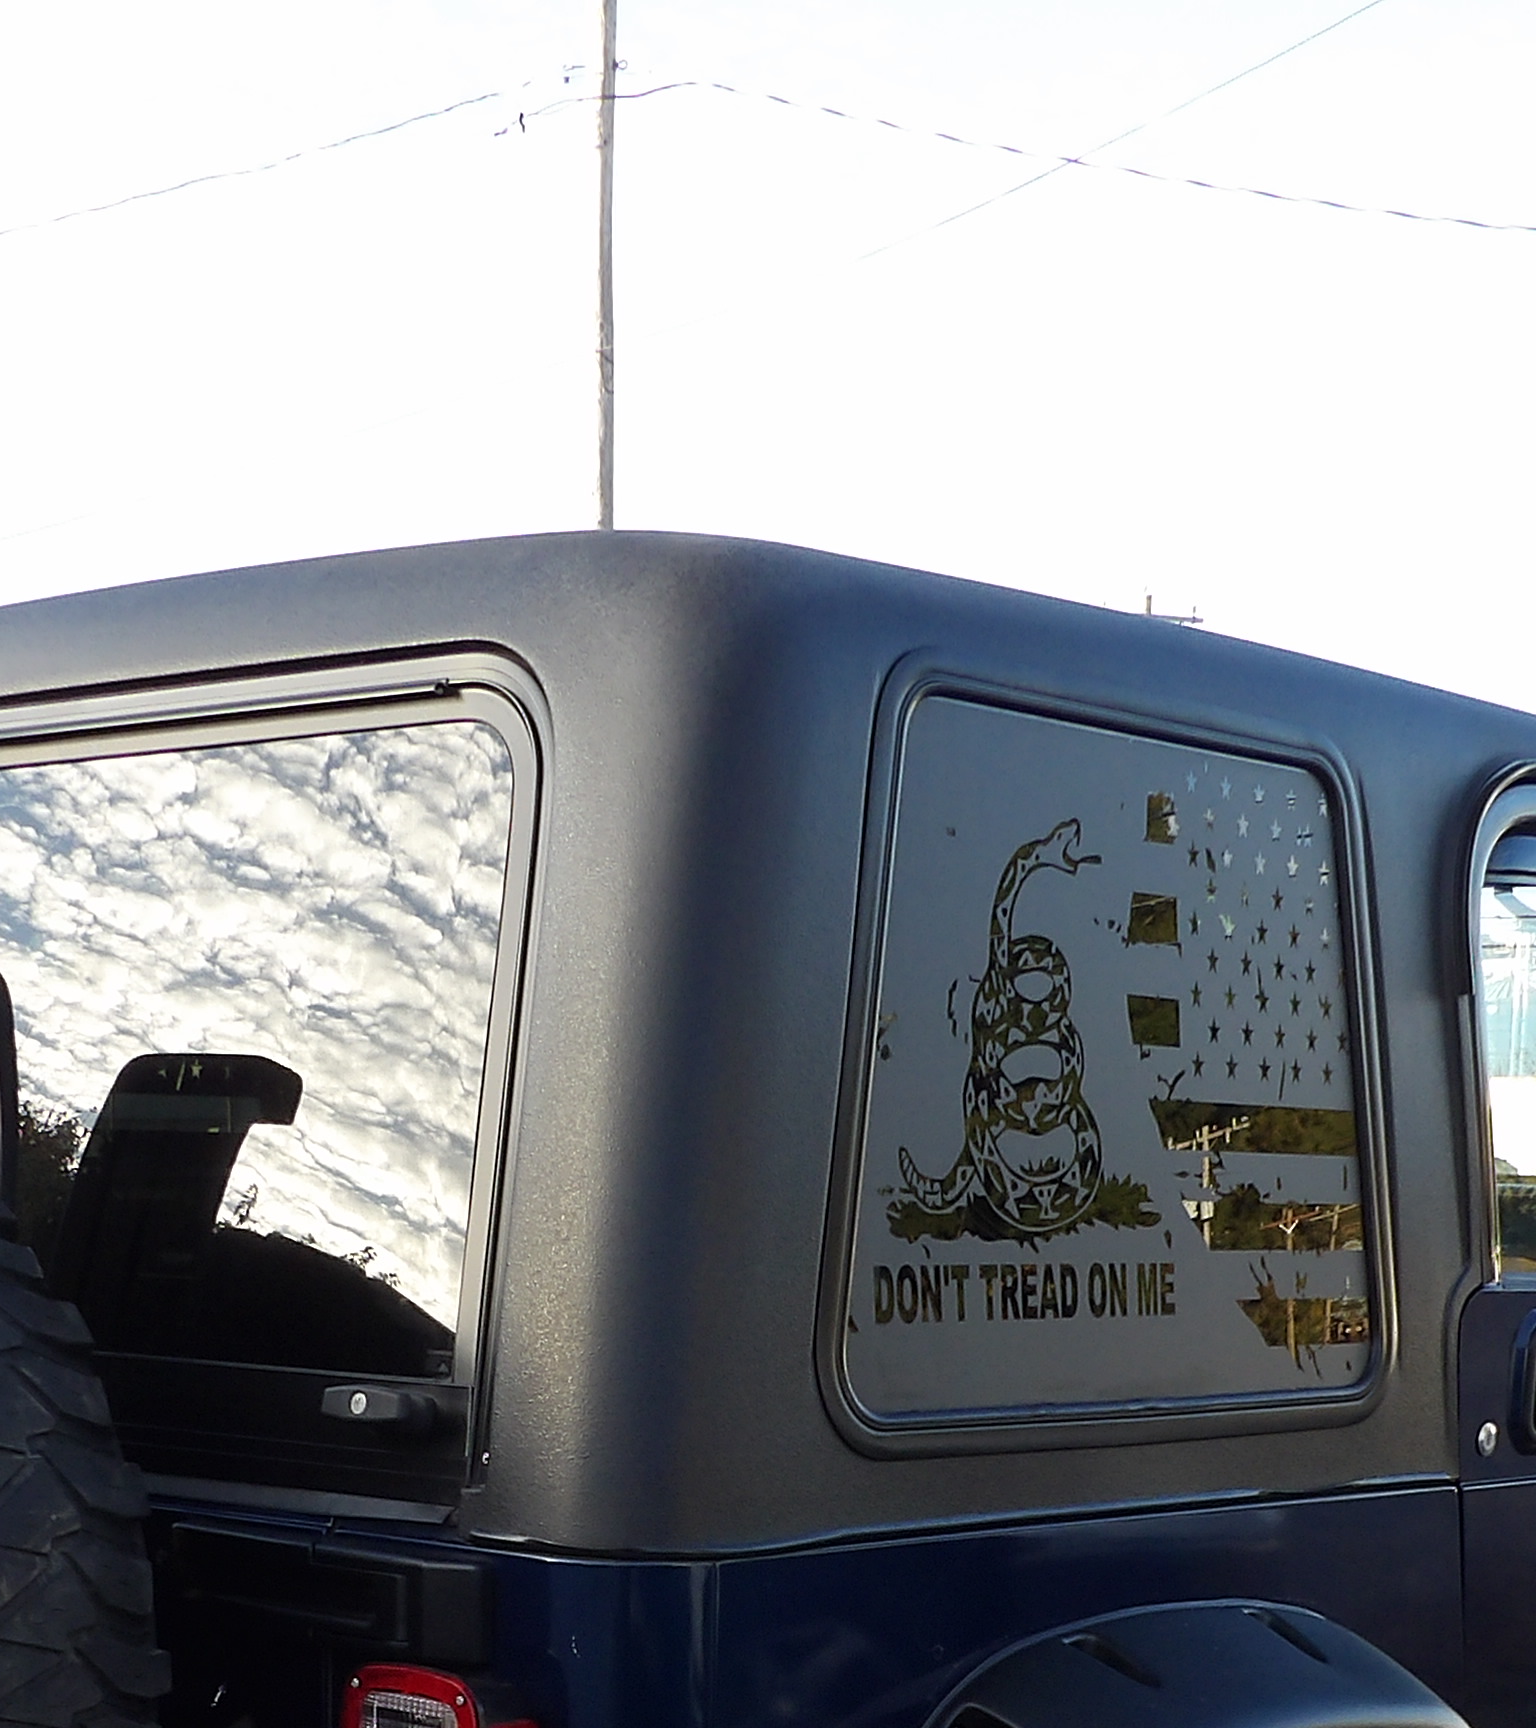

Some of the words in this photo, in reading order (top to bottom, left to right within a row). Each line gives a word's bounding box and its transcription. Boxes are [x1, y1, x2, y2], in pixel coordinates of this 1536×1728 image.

[873, 1264, 970, 1324] DON'T
[978, 1263, 1079, 1322] TREAD
[1087, 1262, 1128, 1319] ON
[1135, 1262, 1177, 1317] ME
